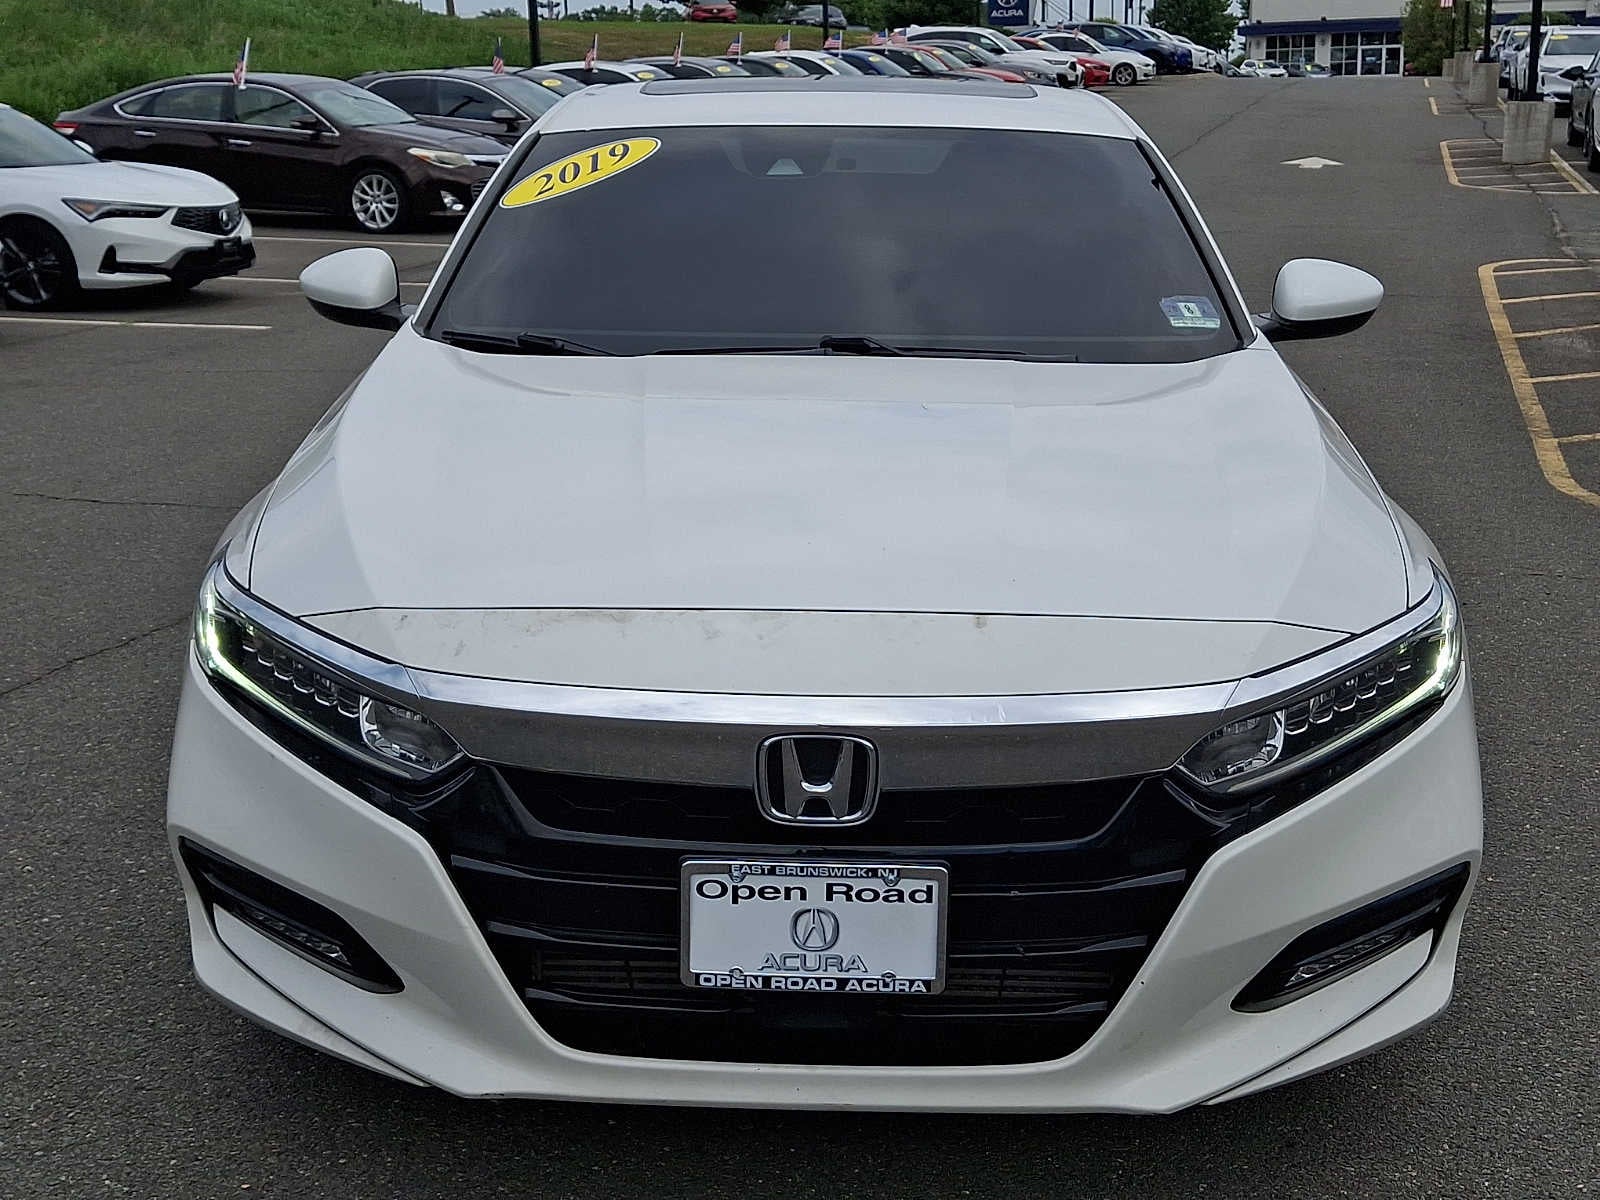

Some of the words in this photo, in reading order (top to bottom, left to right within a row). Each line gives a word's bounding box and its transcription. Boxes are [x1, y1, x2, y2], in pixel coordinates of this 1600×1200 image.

[990, 9, 1024, 17] ACURA
[533, 143, 630, 198] 2019
[731, 864, 771, 875] EAST
[877, 868, 898, 878] NJ
[695, 879, 808, 905] Open
[825, 882, 934, 904] Road
[757, 952, 869, 973] ACURA
[700, 974, 763, 989] OPEN
[770, 976, 837, 991] ROAD
[845, 978, 927, 993] ACURA
